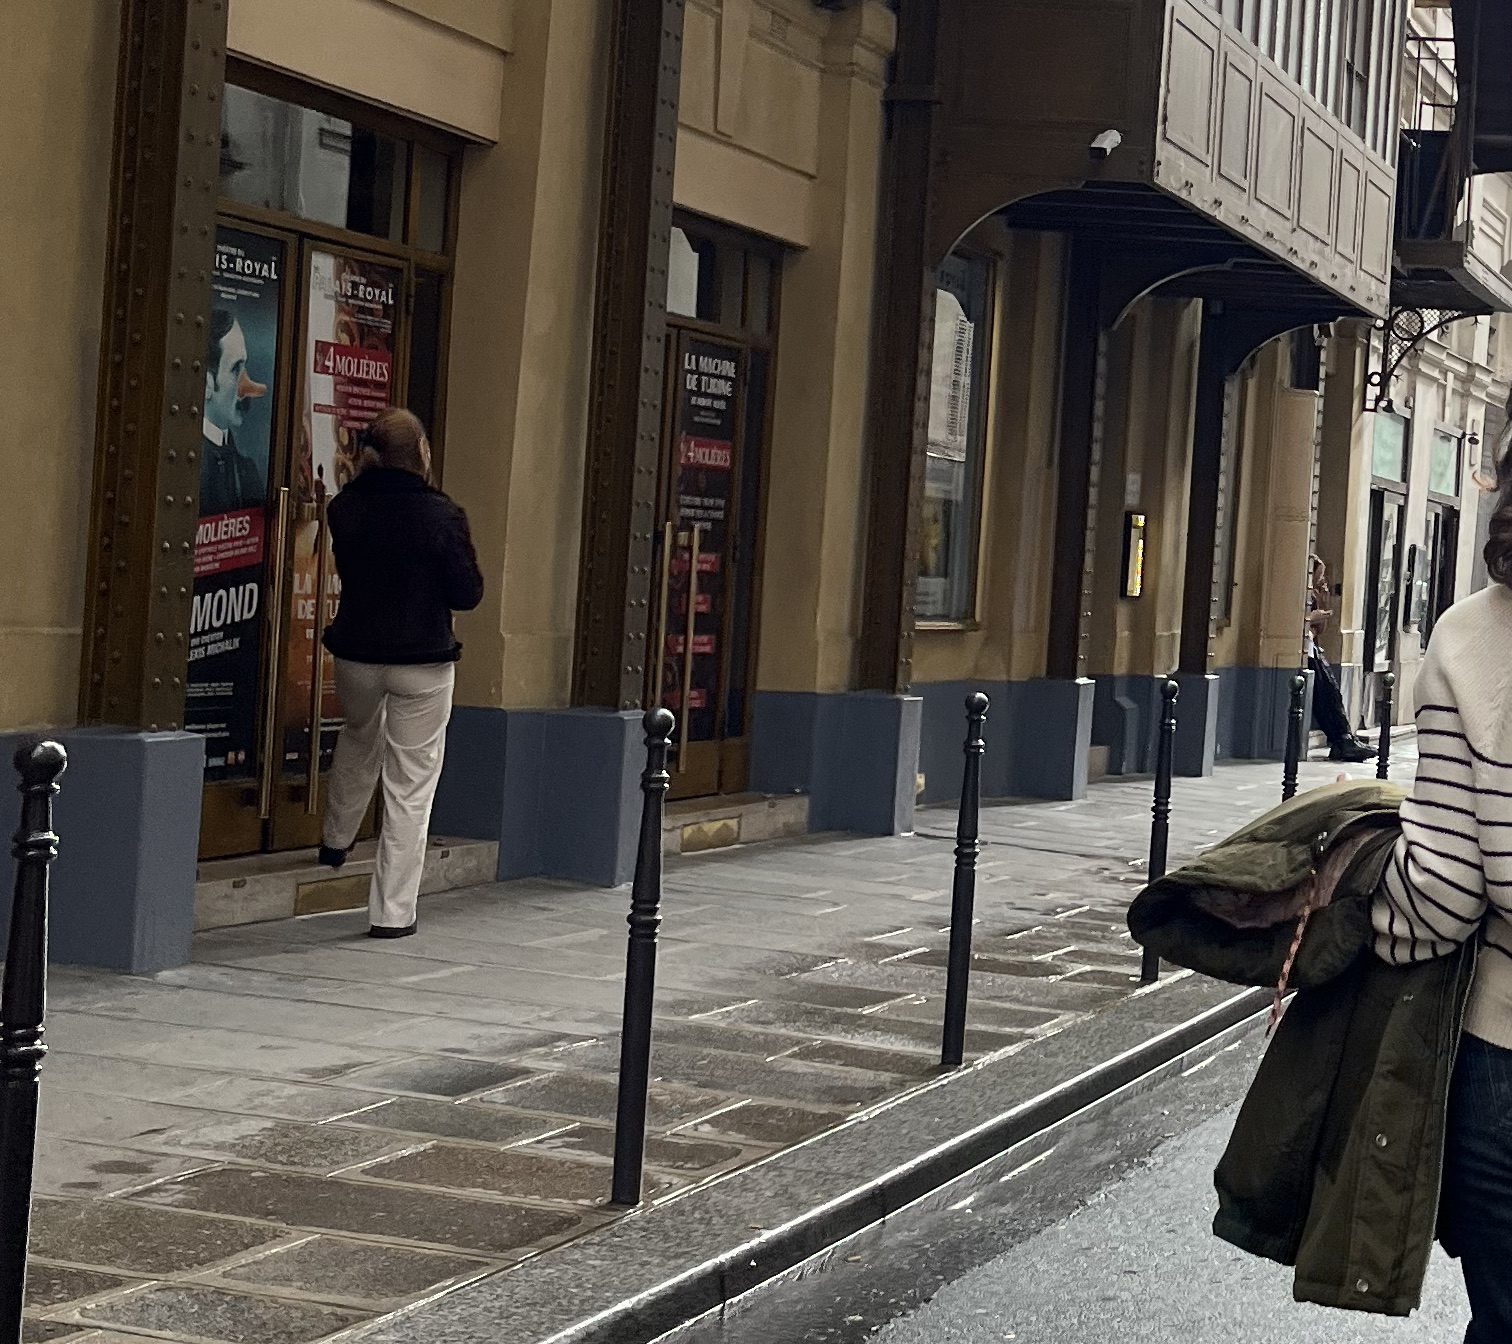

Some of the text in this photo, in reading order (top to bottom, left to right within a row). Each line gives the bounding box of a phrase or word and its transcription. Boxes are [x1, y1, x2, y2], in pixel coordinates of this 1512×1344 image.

[215, 253, 278, 280] IS-ROYAL
[324, 346, 389, 382] 4 MOLIÈRES
[189, 582, 259, 634] MOND
